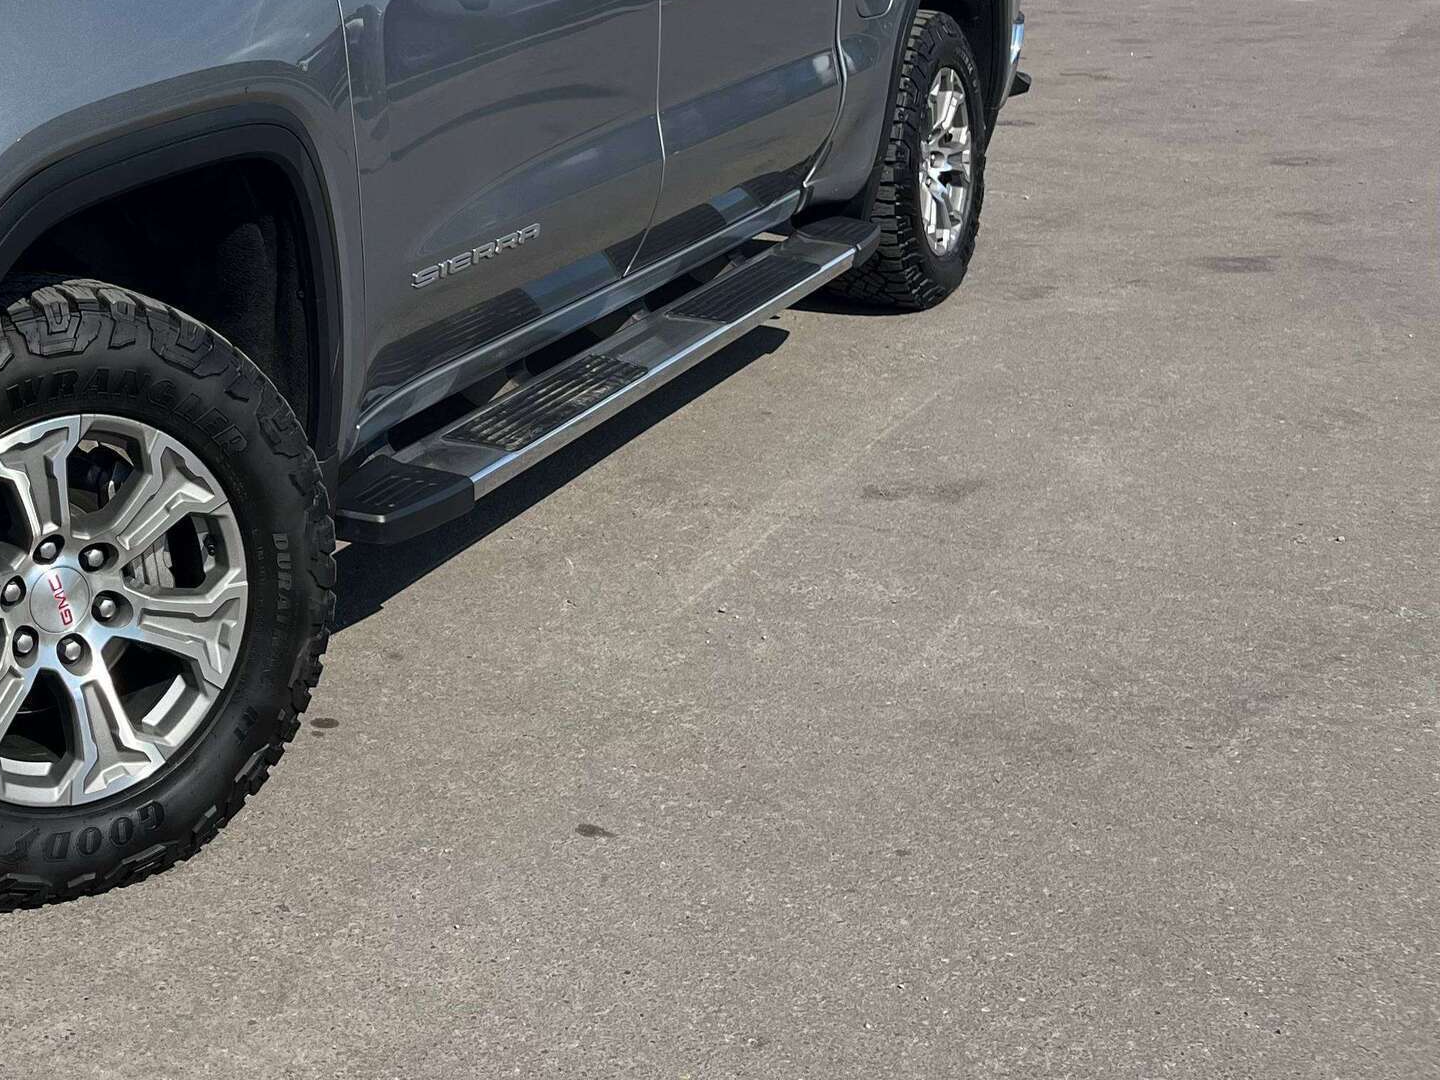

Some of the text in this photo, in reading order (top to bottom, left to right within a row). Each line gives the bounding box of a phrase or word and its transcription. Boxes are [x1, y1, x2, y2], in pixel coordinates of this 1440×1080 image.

[411, 222, 541, 289] SIERRA
[6, 367, 248, 456] WRANGLER
[48, 574, 73, 626] GMC
